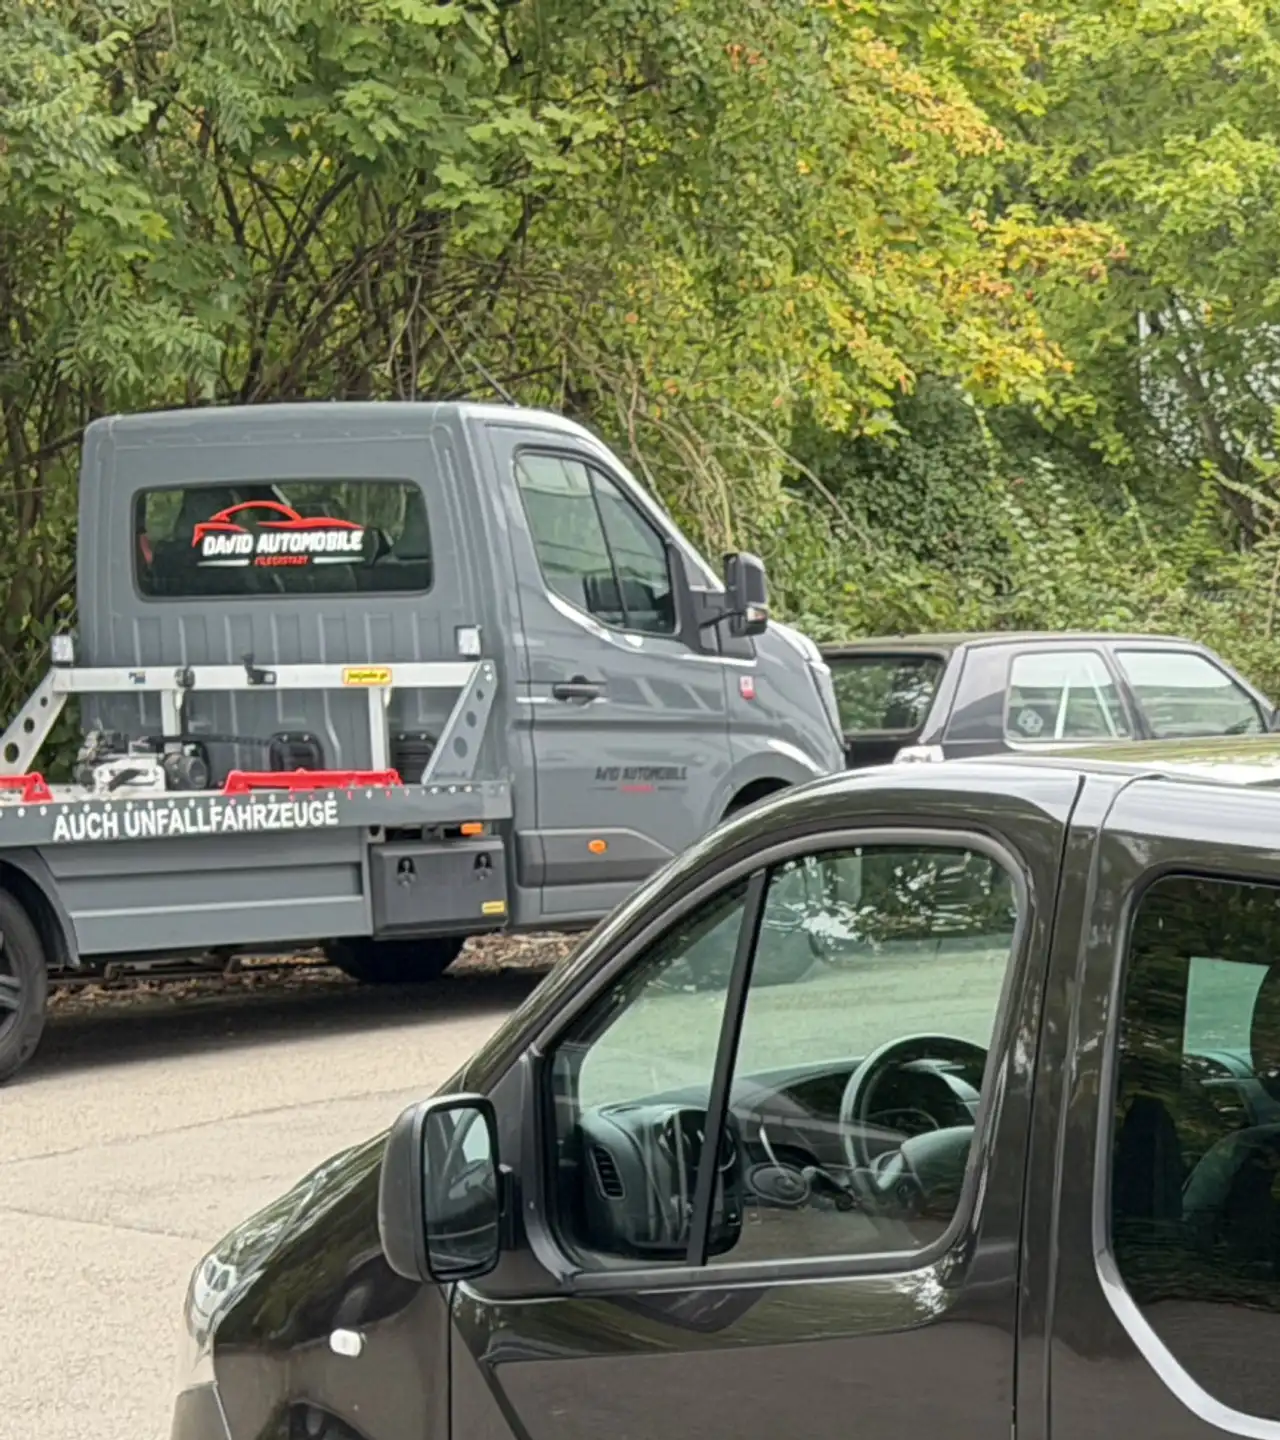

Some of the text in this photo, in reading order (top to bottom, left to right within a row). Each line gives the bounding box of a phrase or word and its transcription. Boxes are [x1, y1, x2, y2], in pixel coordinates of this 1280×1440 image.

[203, 530, 364, 556] DAVID AUTOMOBILE
[53, 799, 338, 842] AUCH UNFALLFAHRZEUGE
